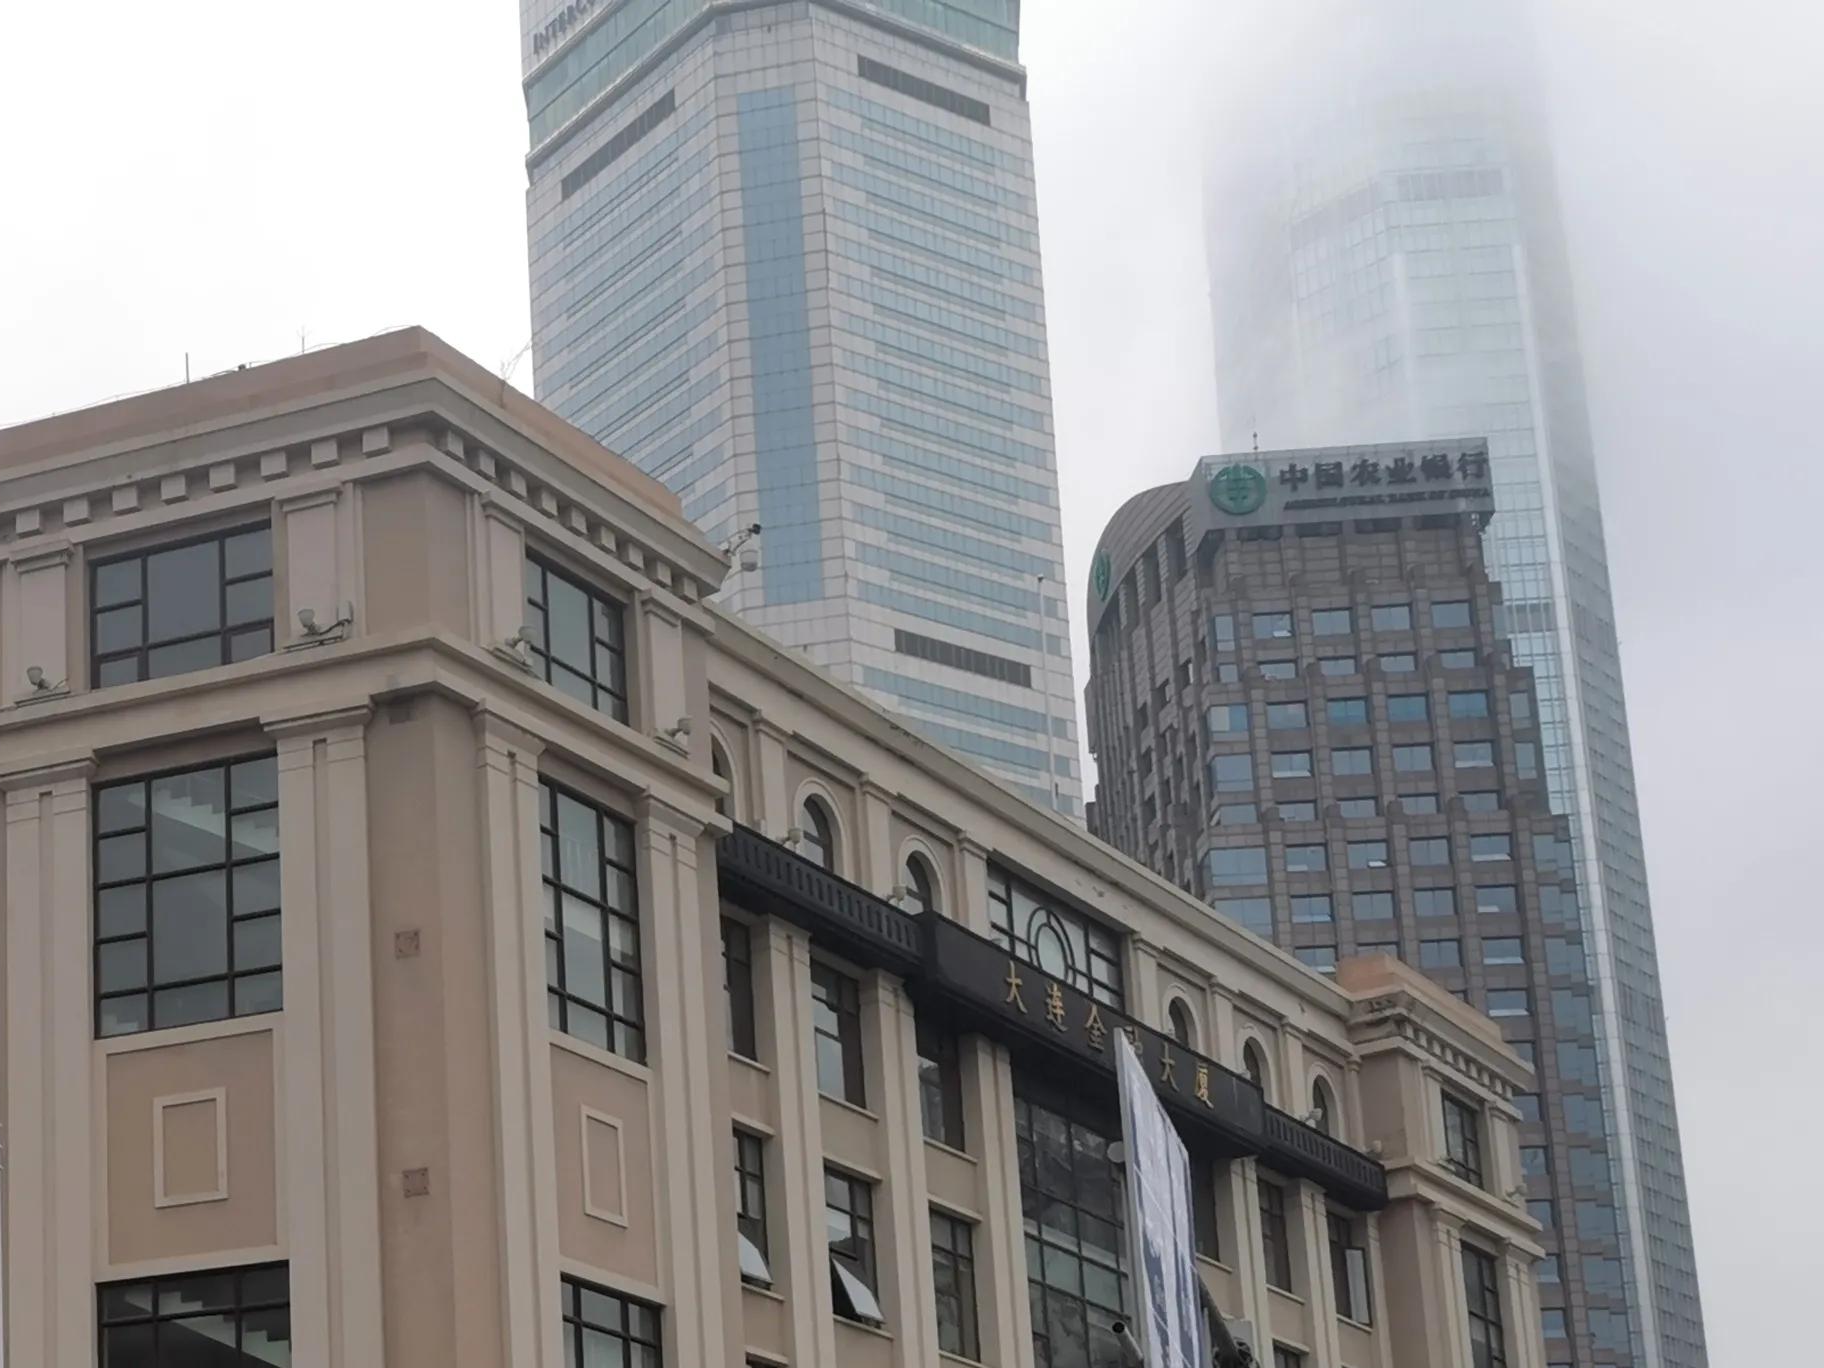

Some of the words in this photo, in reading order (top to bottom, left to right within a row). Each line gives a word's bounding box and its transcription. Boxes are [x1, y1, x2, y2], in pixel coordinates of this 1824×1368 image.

[1280, 452, 1488, 492] 中国农业银行
